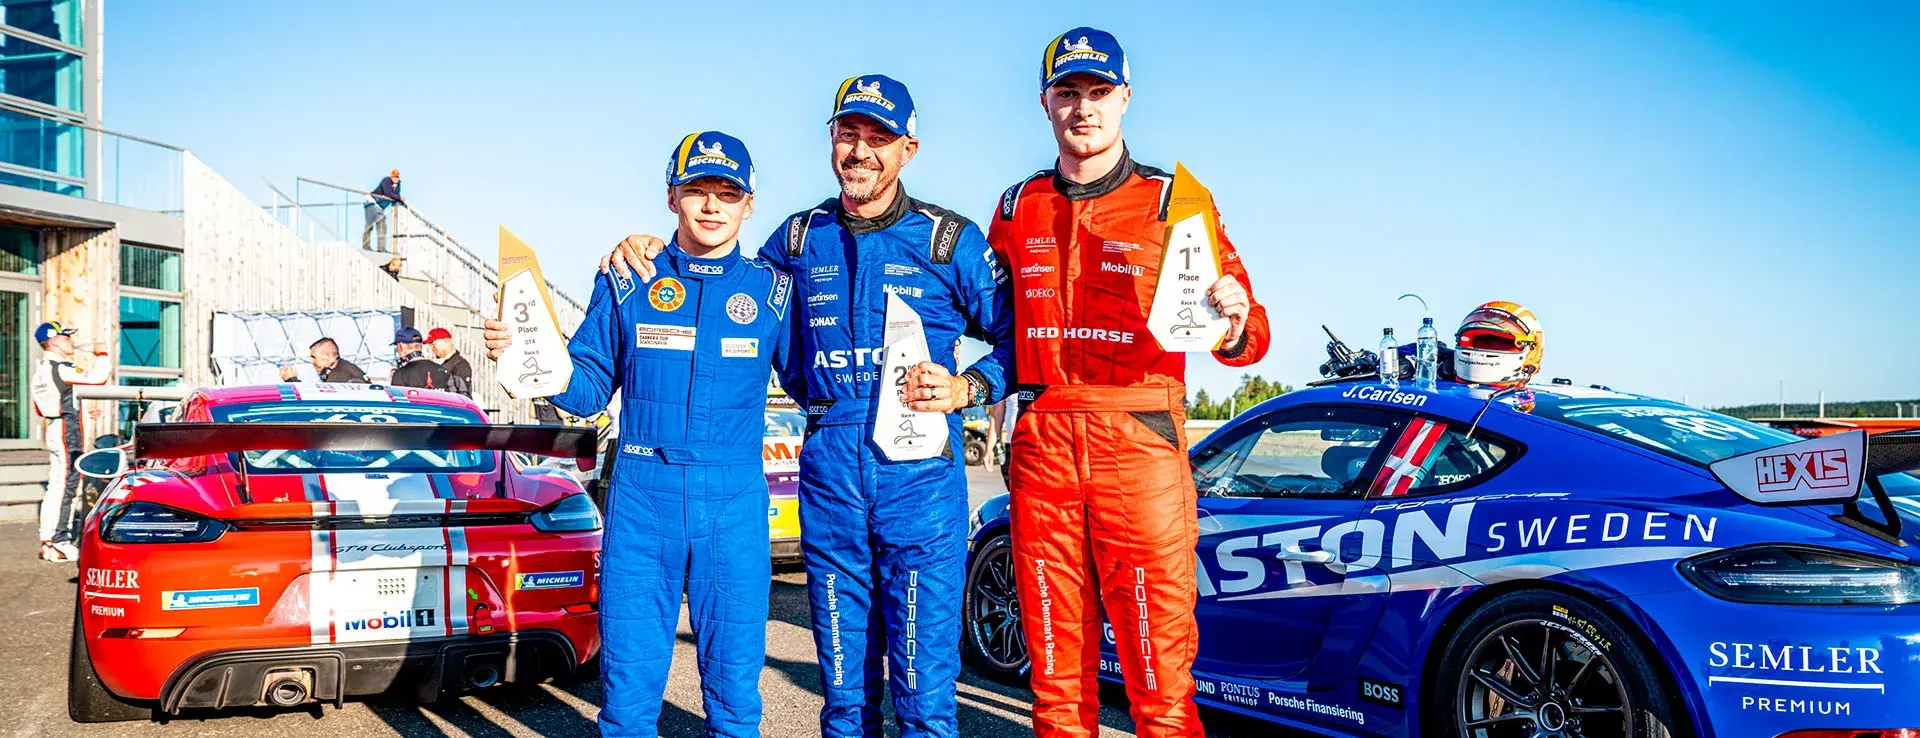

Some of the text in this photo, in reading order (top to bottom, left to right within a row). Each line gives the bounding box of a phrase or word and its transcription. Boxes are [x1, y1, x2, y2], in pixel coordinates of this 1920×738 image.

[1055, 53, 1108, 68] MICHELIN
[844, 95, 895, 111] MICHELIN
[688, 157, 739, 171] MICHELIN
[938, 221, 957, 257] sparco
[1026, 237, 1056, 245] SEMLER
[1179, 247, 1201, 270] 1st
[689, 263, 723, 274] sparco
[811, 265, 839, 275] SEMLER
[1021, 263, 1054, 274] martinsen
[1101, 262, 1131, 274] Mobil
[1178, 274, 1200, 282] Place
[773, 275, 789, 306] sparco
[808, 292, 838, 302] martinsen
[883, 284, 911, 296] Mobil
[513, 300, 536, 323] 3rd
[518, 326, 538, 334] Place
[810, 317, 838, 327] SONAX
[1027, 327, 1134, 344] RED HORSE
[814, 347, 884, 369] ASTO
[1342, 386, 1427, 407] J.Carlsen
[624, 444, 654, 456] sparco
[1757, 450, 1849, 491] HEXIS
[1370, 492, 1572, 514] PORSCHE
[1487, 512, 1718, 552] SWEDEN
[335, 543, 447, 554] GT4 Clubsport
[86, 568, 140, 589] SEMLER
[537, 575, 579, 585] MICHELIN
[91, 604, 125, 617] PREMIUM
[1035, 559, 1054, 675] Porsche Denmark Racing
[345, 610, 412, 631] Mobil
[827, 573, 843, 686] Porsche Denmark Racing
[1134, 566, 1157, 691] PORSCHE
[907, 570, 918, 691] PORSCHE
[1709, 641, 1884, 674] SEMLER
[1220, 681, 1260, 697] PONTUS
[1363, 681, 1399, 702] BOSS
[1268, 692, 1365, 725] Porsche Finansiering
[1742, 696, 1851, 716] PREMIUM
